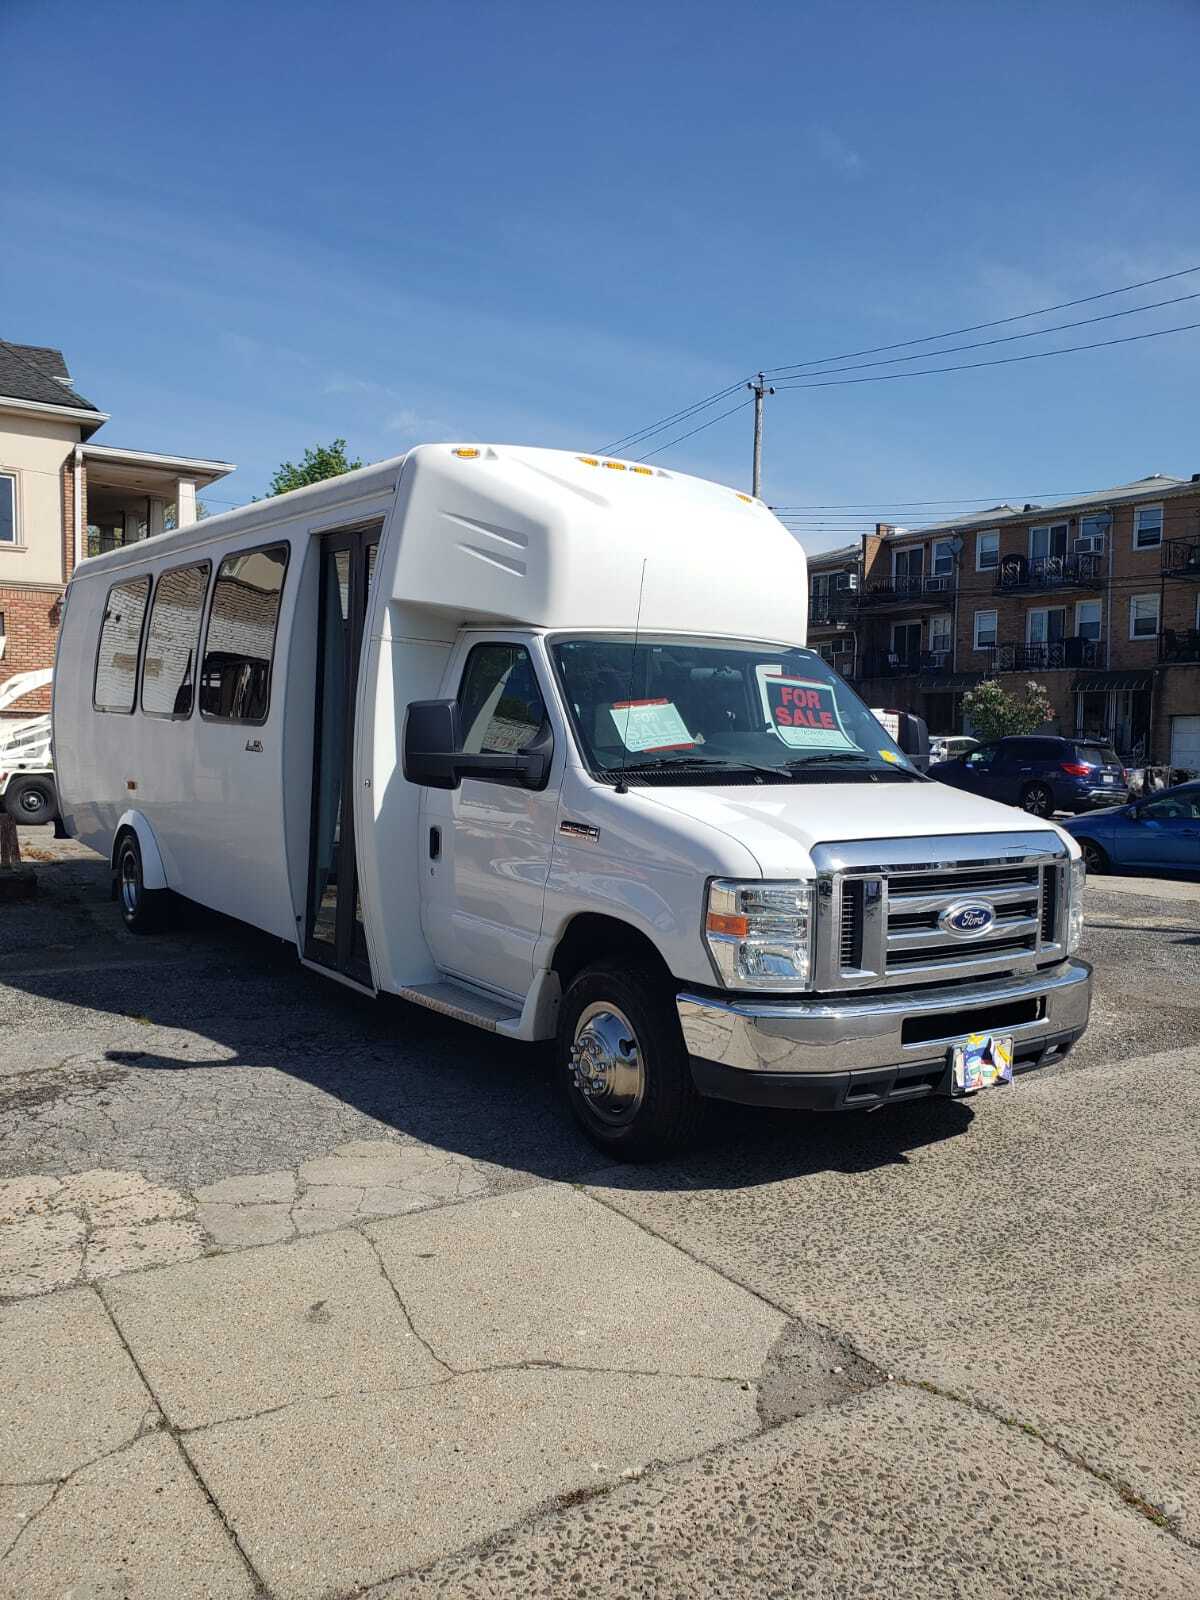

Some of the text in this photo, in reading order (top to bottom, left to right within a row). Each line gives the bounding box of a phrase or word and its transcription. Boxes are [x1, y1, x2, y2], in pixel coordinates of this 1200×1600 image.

[781, 687, 821, 708] FOR
[775, 706, 836, 728] SALE
[962, 911, 985, 926] Ford
